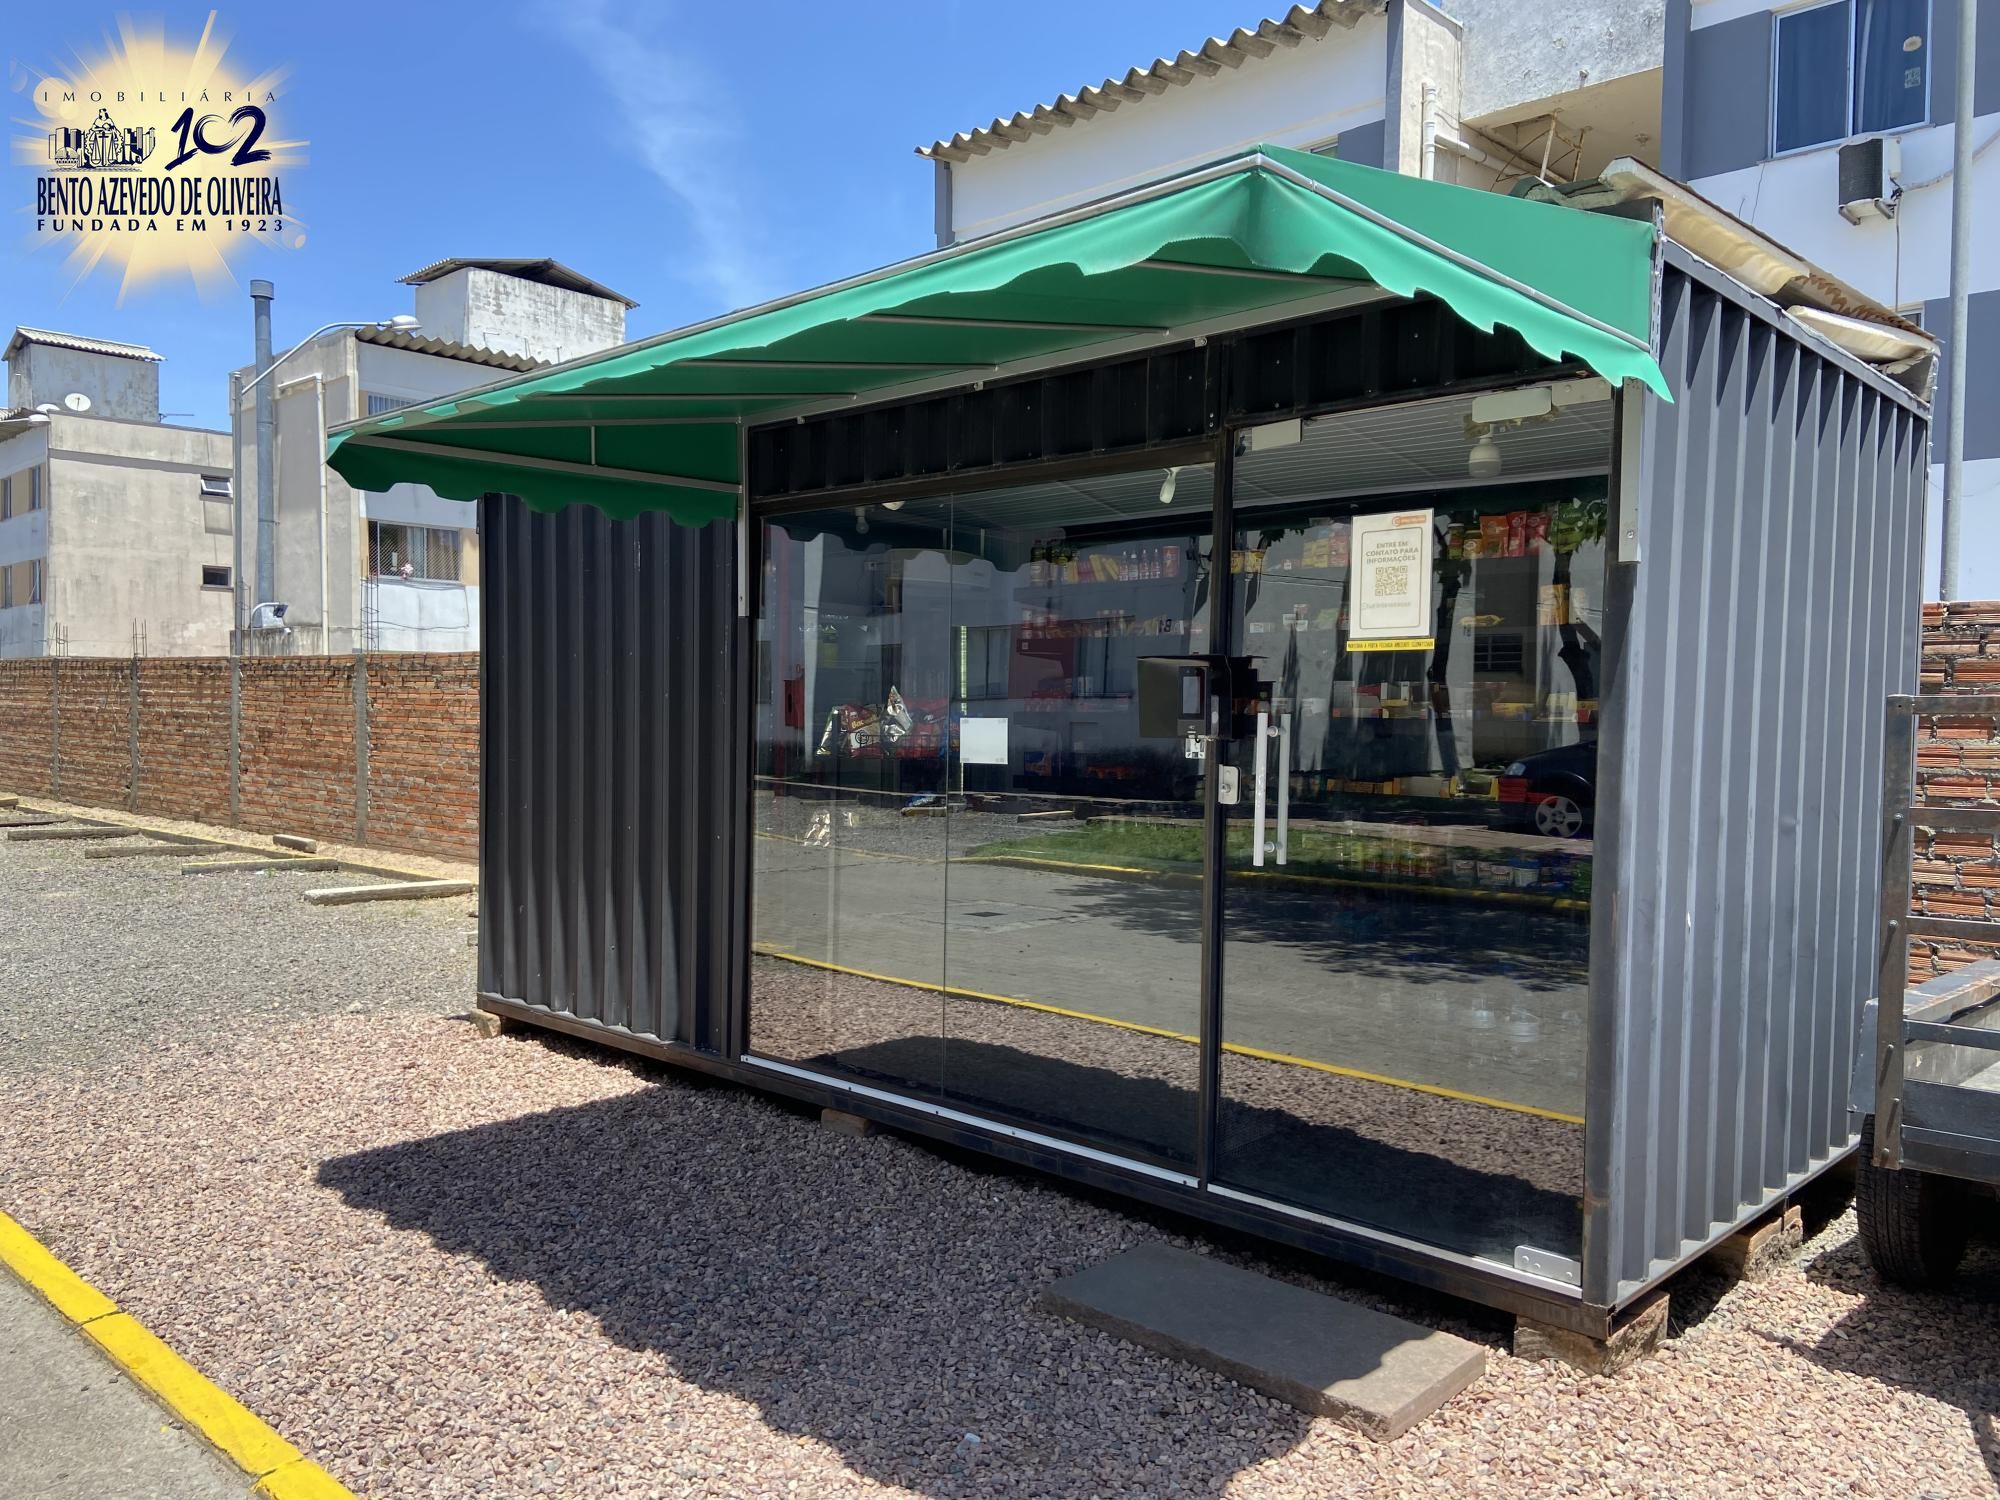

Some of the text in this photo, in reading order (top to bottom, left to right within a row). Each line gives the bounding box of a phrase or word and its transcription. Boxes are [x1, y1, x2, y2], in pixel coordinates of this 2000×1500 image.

[1376, 541, 1396, 549] ENTRE
[1365, 546, 1419, 557] CONTATO PARA
